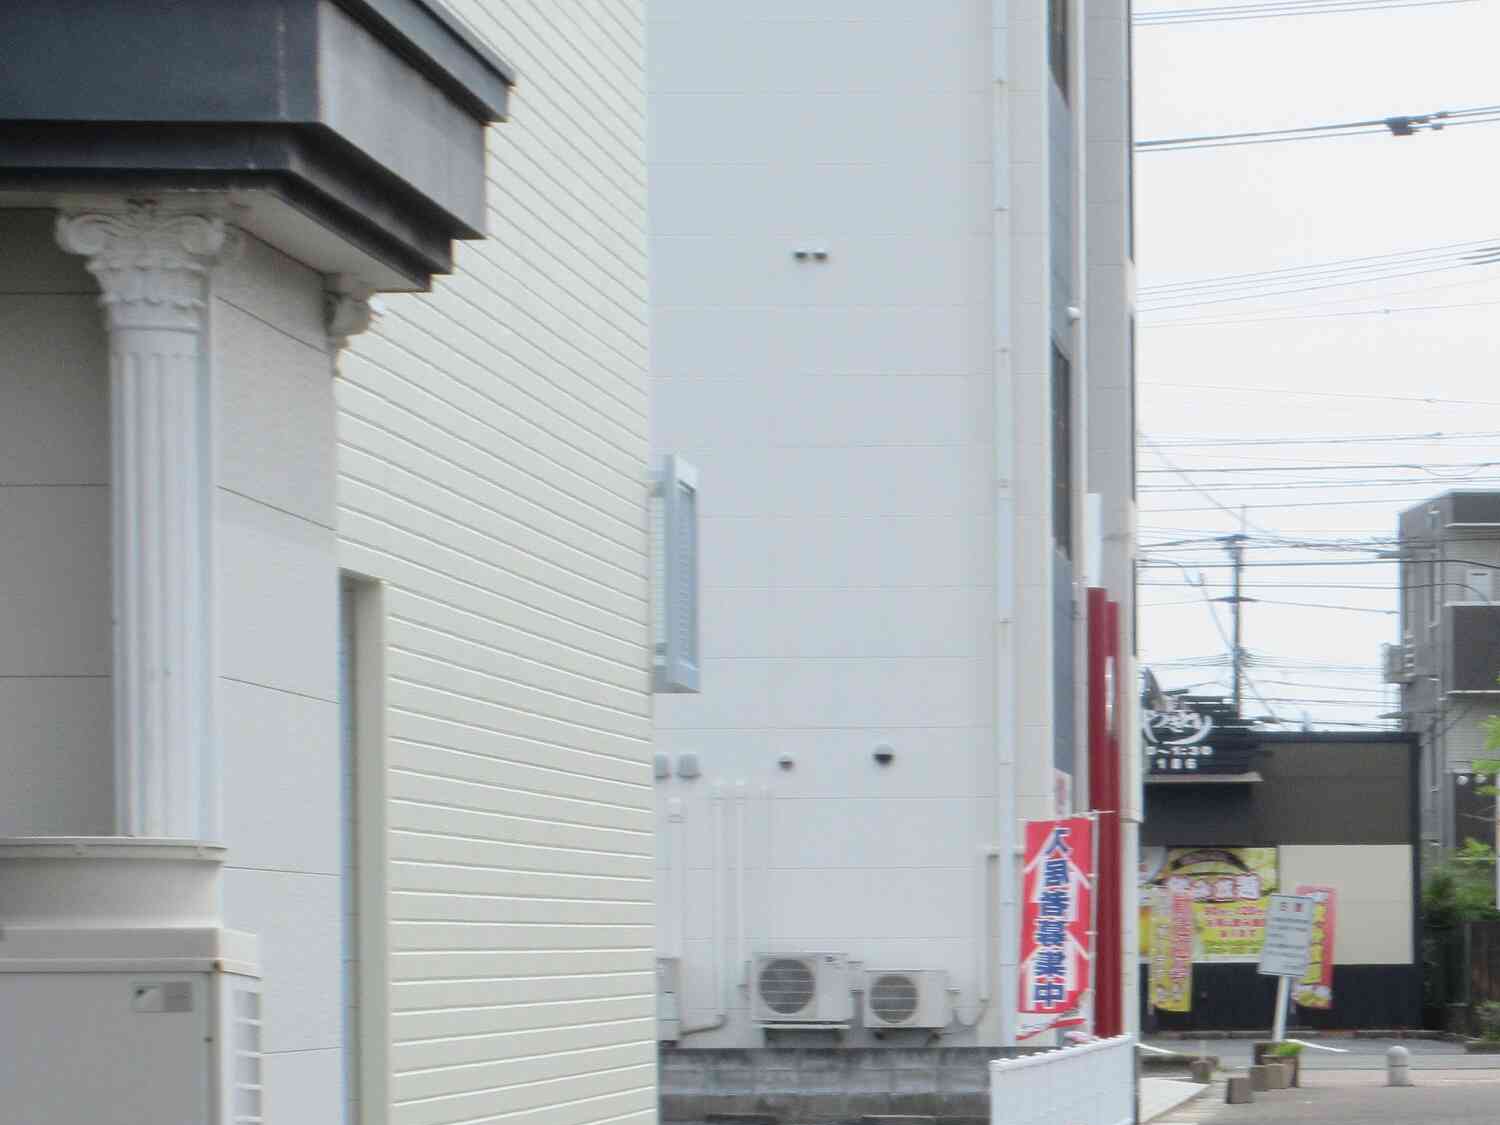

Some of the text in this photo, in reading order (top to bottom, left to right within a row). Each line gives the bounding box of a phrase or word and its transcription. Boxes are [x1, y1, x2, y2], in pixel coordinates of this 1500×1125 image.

[1034, 828, 1072, 1008] 入居者募集中
